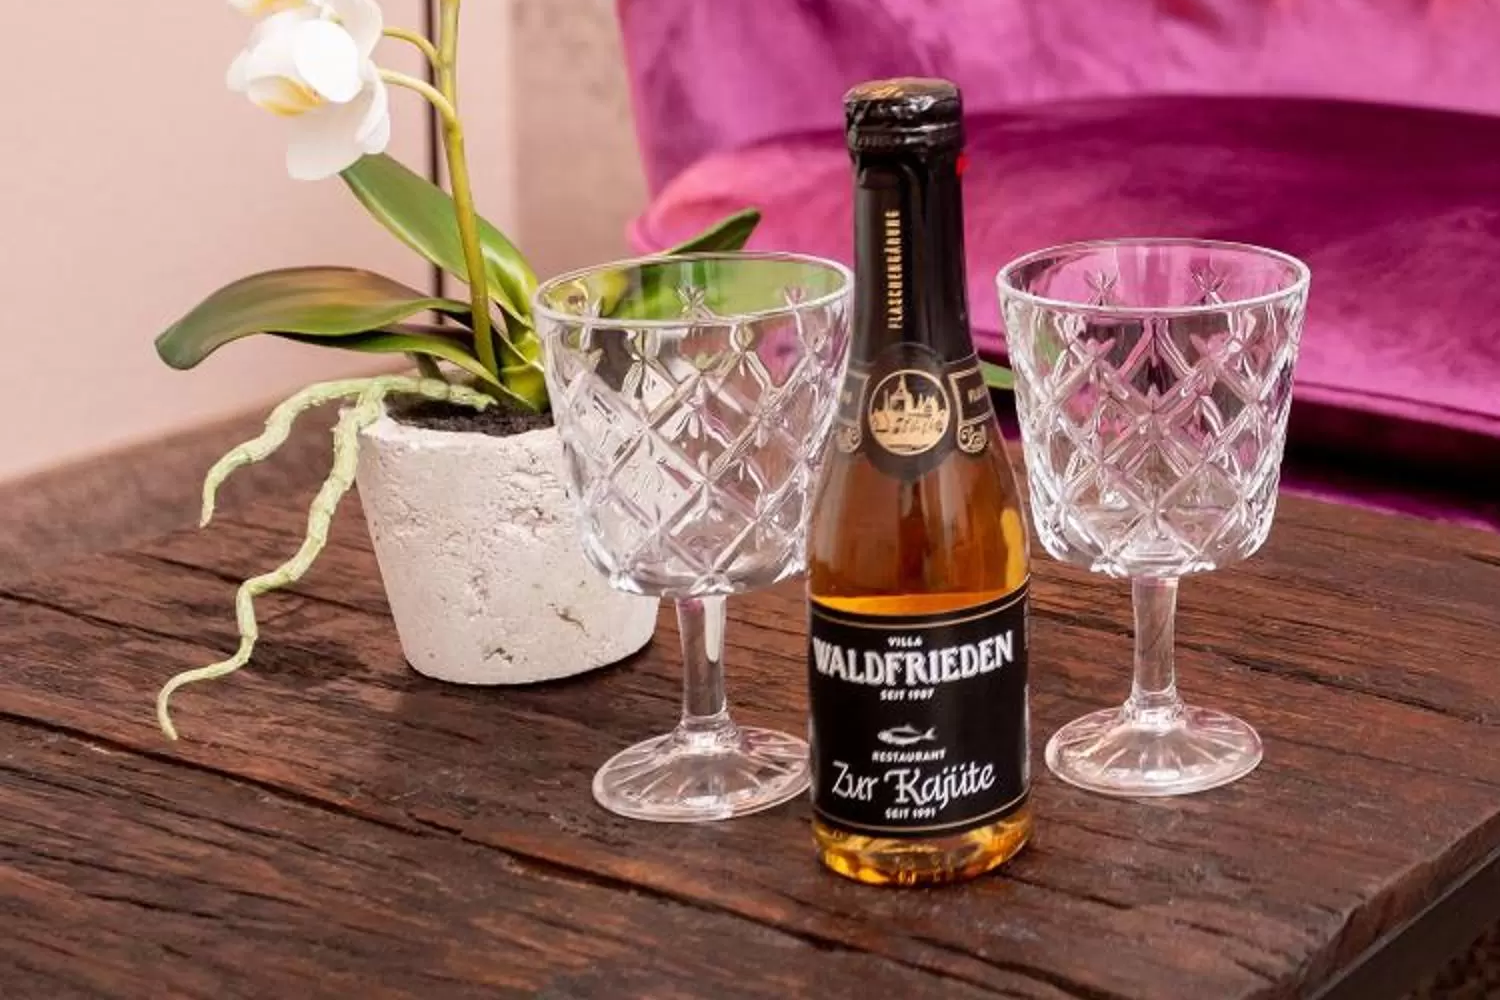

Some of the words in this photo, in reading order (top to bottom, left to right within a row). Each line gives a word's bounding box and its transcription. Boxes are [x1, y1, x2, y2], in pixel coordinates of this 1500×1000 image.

[887, 635, 923, 648] VILLA
[812, 630, 1014, 687] WALDFRIEDEN
[880, 688, 905, 701] SEIT
[871, 748, 946, 763] RESTAURANT
[832, 760, 879, 801] Zur
[883, 760, 996, 810] Kajüte
[885, 807, 909, 820] SEIT
